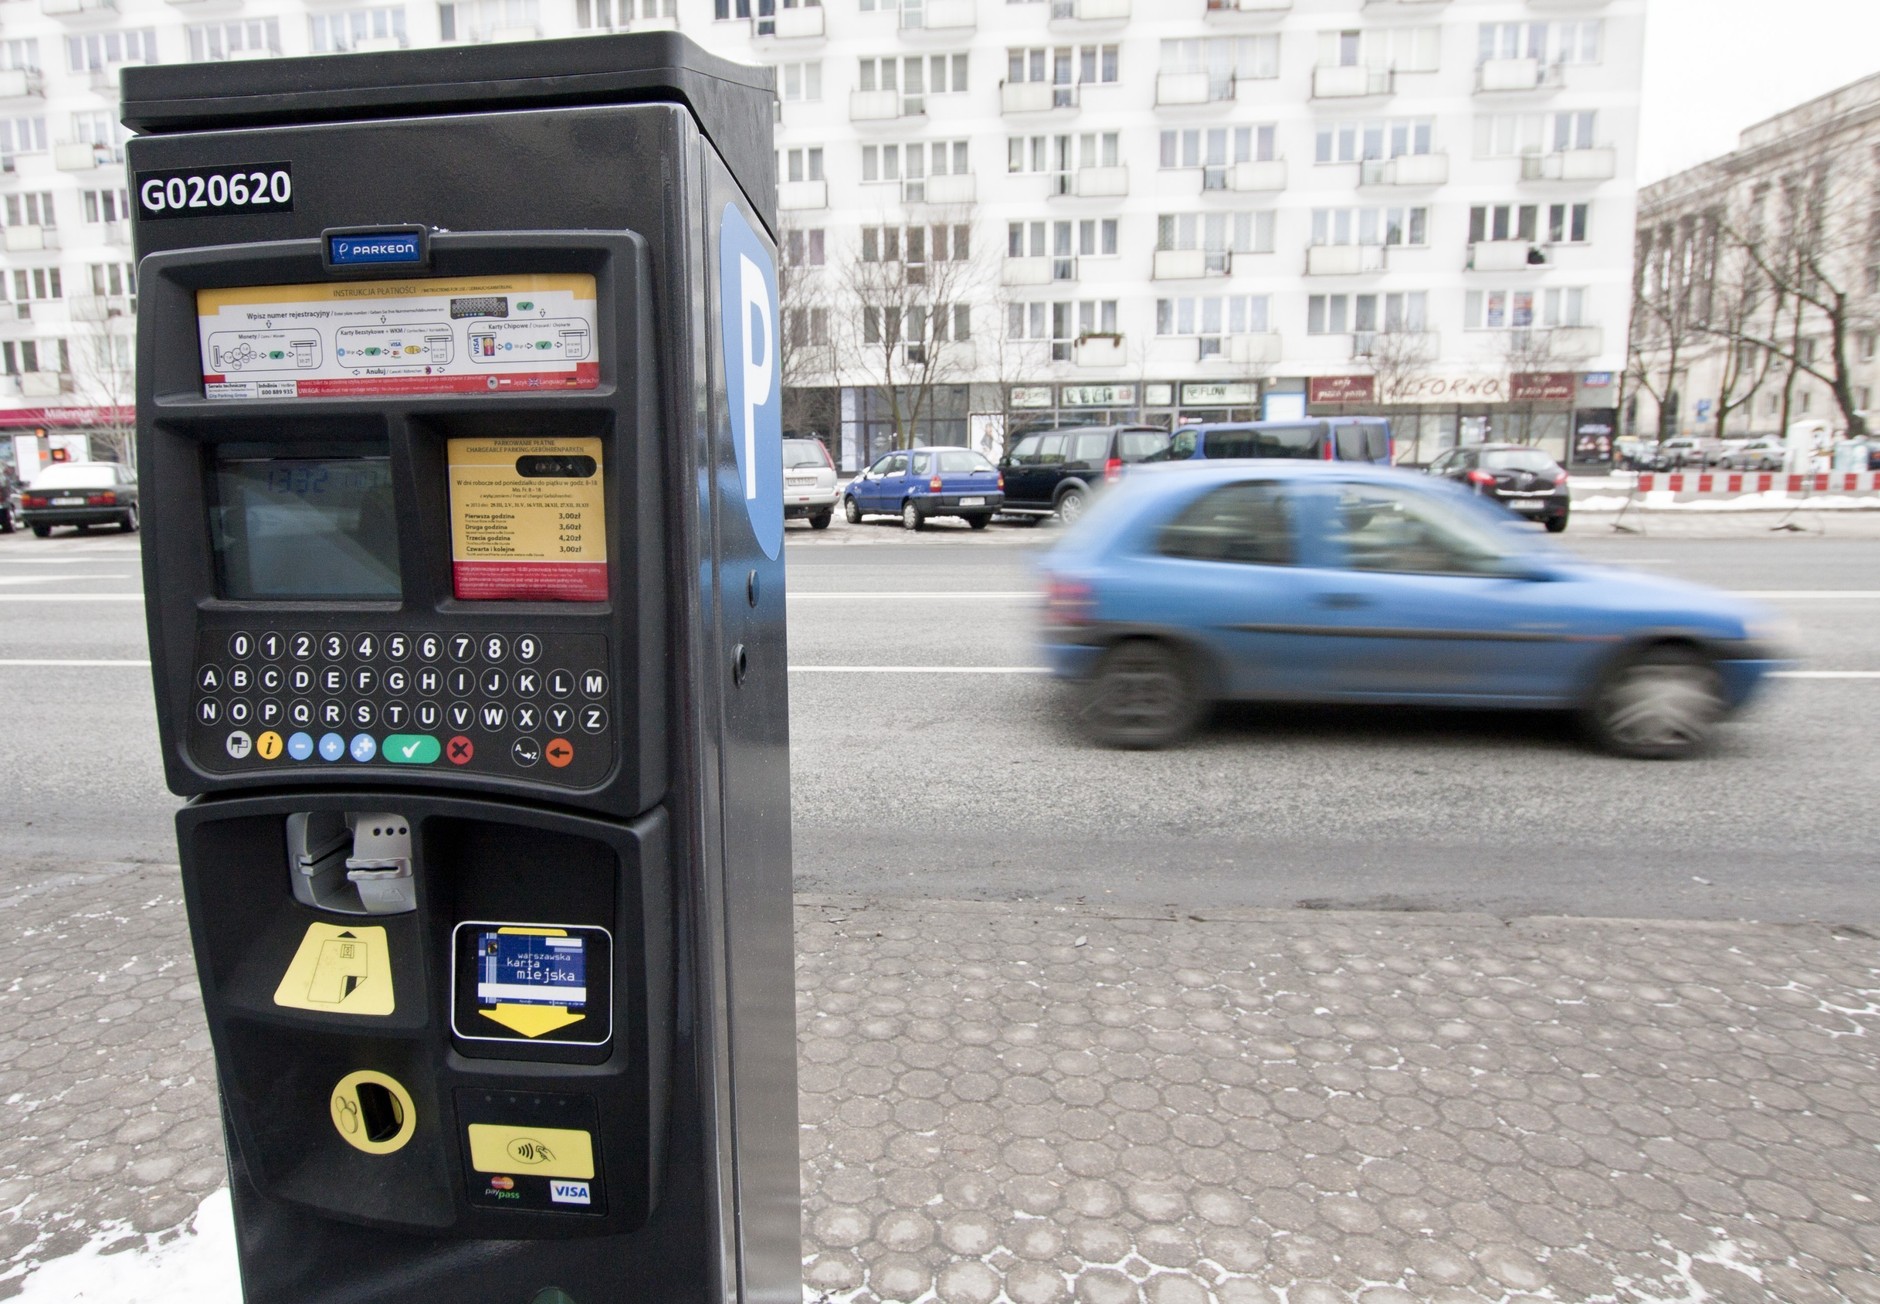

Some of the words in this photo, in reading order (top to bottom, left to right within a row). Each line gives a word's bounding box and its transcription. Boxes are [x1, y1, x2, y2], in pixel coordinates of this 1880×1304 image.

[141, 170, 291, 210] G020620
[353, 244, 414, 254] PARKEON
[334, 288, 374, 296] INSTRUKCJA
[377, 286, 416, 295] PŁATNOŚCI
[289, 310, 330, 318] rejestracyjny
[504, 322, 528, 330] Chipowe
[540, 378, 566, 386] Language
[740, 253, 773, 500] P
[236, 636, 248, 654] 0
[266, 636, 276, 656] 1
[296, 636, 308, 656] 2
[328, 638, 340, 656] 3
[360, 638, 372, 656] 4
[392, 638, 404, 656] 5
[424, 638, 436, 658] 6
[456, 638, 468, 658] 7
[488, 638, 500, 658] 8
[522, 640, 534, 658] 9
[204, 670, 216, 686] A
[234, 670, 246, 686] B
[264, 672, 278, 686] C
[296, 672, 308, 688] D
[328, 672, 340, 688] E
[360, 672, 370, 688] F
[390, 672, 404, 688] G
[422, 674, 436, 690] H
[458, 674, 464, 690] I
[488, 674, 498, 690] J
[520, 676, 534, 692] K
[556, 676, 566, 692] L
[586, 676, 602, 692] M
[204, 704, 216, 718] N
[232, 704, 246, 720] O
[266, 704, 276, 720] P
[294, 704, 308, 722] Q
[326, 706, 340, 722] R
[358, 706, 370, 722] S
[390, 706, 402, 722] T
[422, 708, 434, 724] U
[454, 708, 468, 724] V
[484, 708, 504, 726] W
[520, 710, 532, 726] X
[554, 710, 566, 726] Y
[586, 710, 600, 728] Z
[266, 736, 274, 754] i
[507, 958, 540, 968] karta
[518, 953, 571, 961] warszawska
[516, 968, 575, 983] miejska
[555, 1186, 588, 1198] VISA
